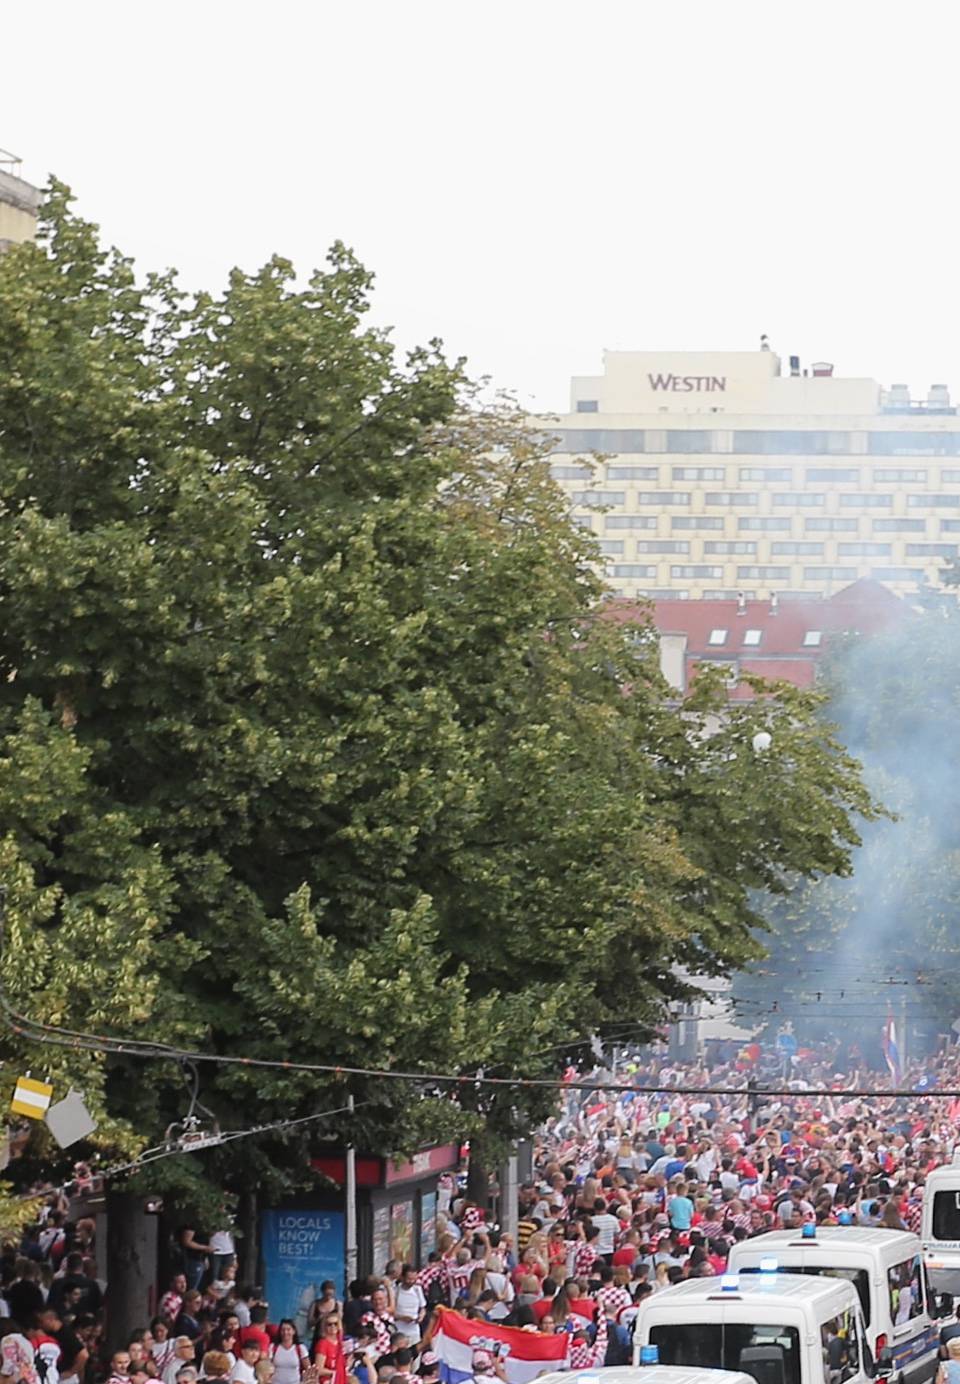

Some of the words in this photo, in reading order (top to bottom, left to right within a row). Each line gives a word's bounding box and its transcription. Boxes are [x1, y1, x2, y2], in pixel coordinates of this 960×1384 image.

[647, 373, 726, 392] WESTIN
[279, 1216, 331, 1230] LOCALS
[279, 1230, 321, 1242] KNOW
[279, 1243, 314, 1255] BEST!
